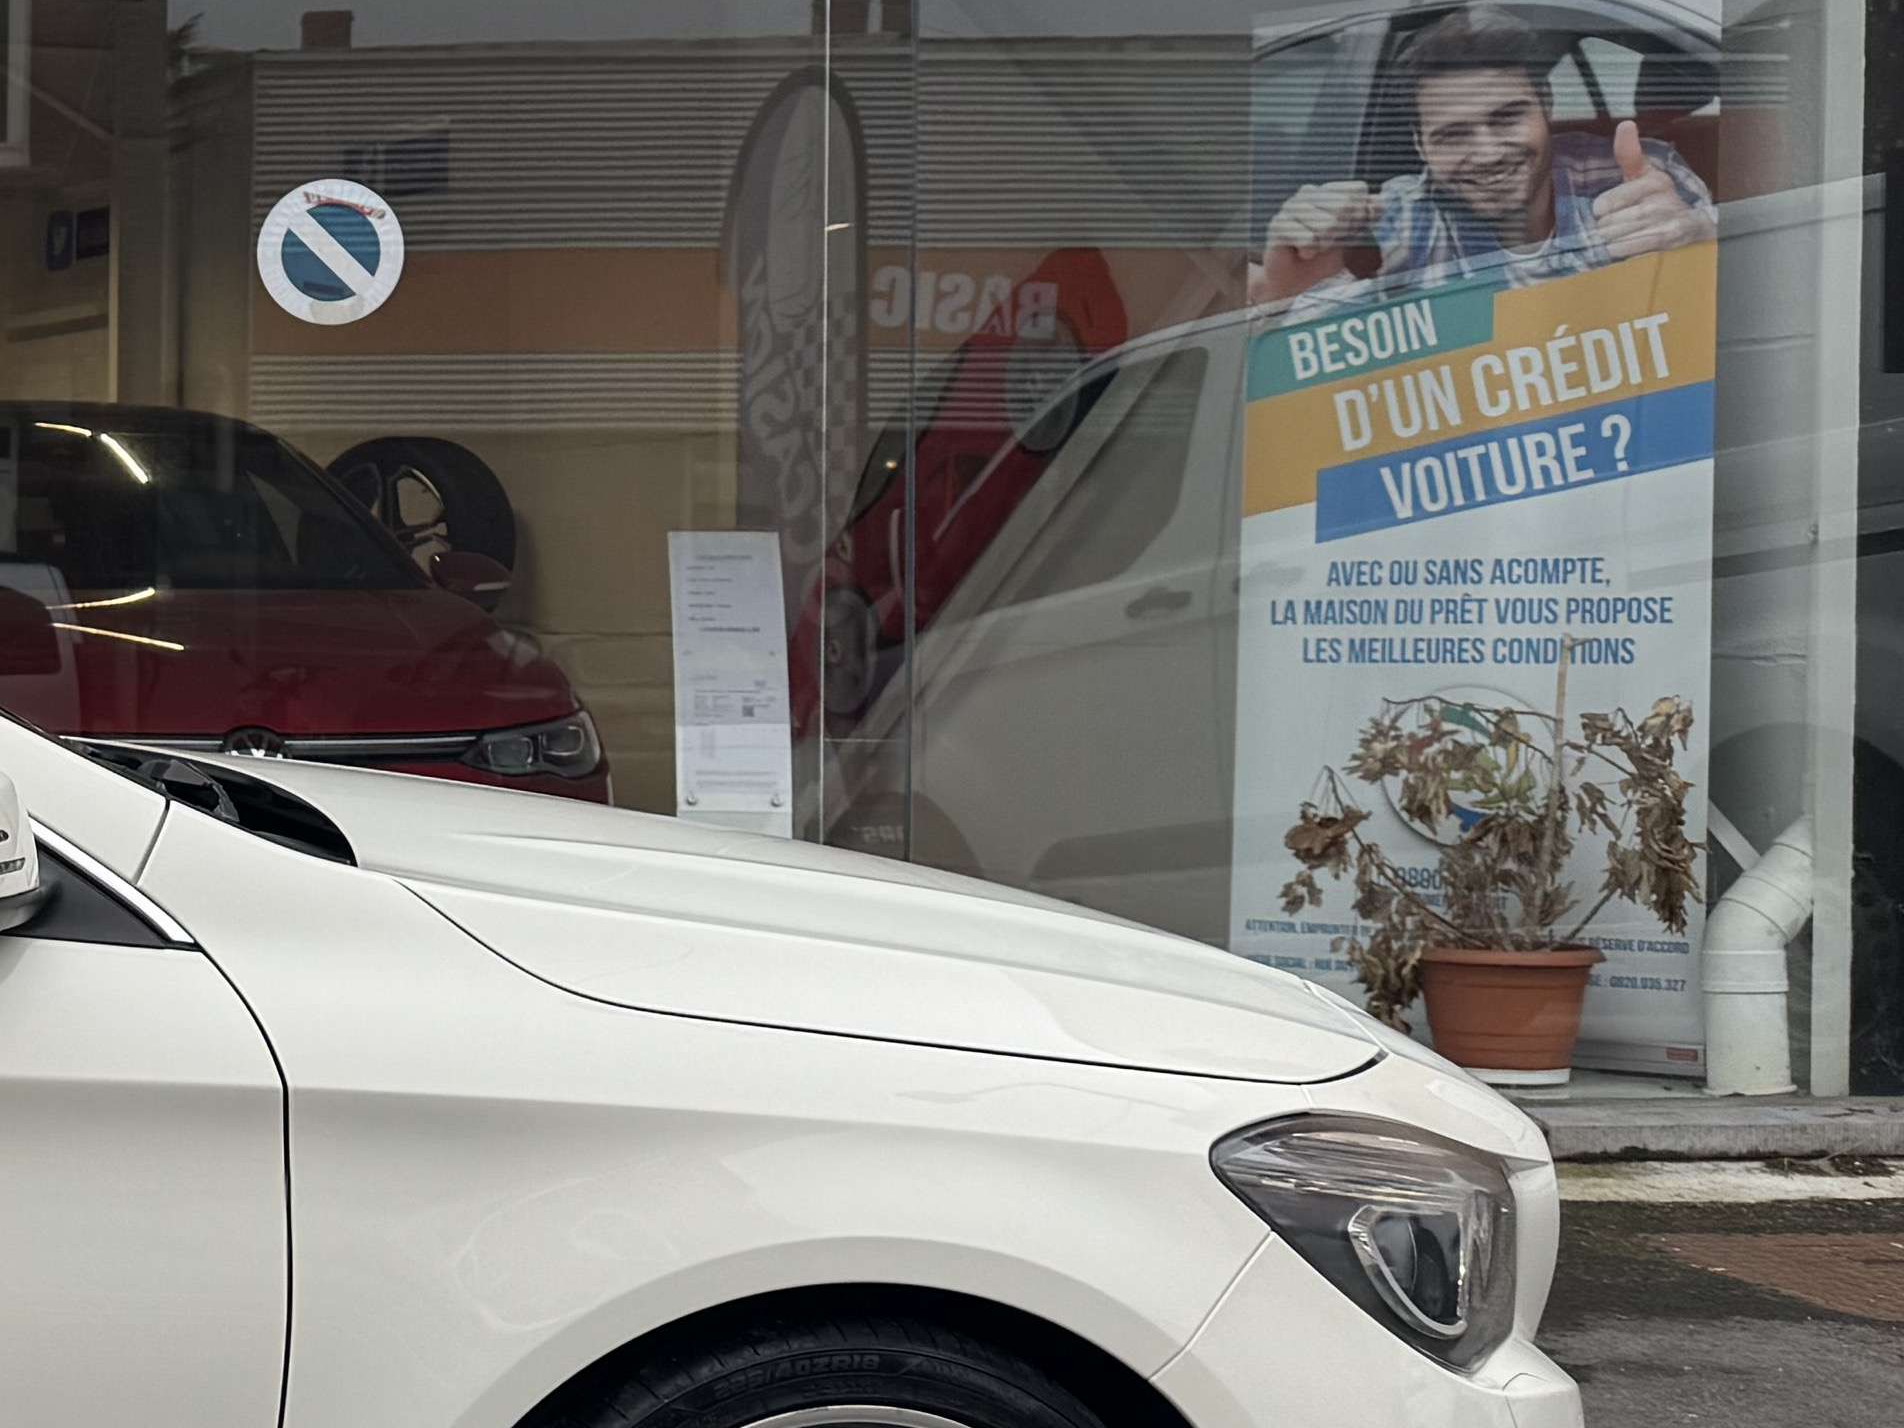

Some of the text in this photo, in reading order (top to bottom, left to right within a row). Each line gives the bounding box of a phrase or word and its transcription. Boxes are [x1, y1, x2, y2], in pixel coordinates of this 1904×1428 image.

[1288, 299, 1438, 380] BESOIN
[1333, 313, 1670, 452] D'UN CRÉDIT
[1379, 414, 1633, 520] VOITURE ?
[1327, 557, 1611, 589] AVEC OU SANS ACOMPTE,
[1270, 593, 1674, 626] LA MAISON DU PRÊT VOUS PROPOSE
[1302, 638, 1341, 664] LES
[1348, 638, 1485, 665] MEILLEURES
